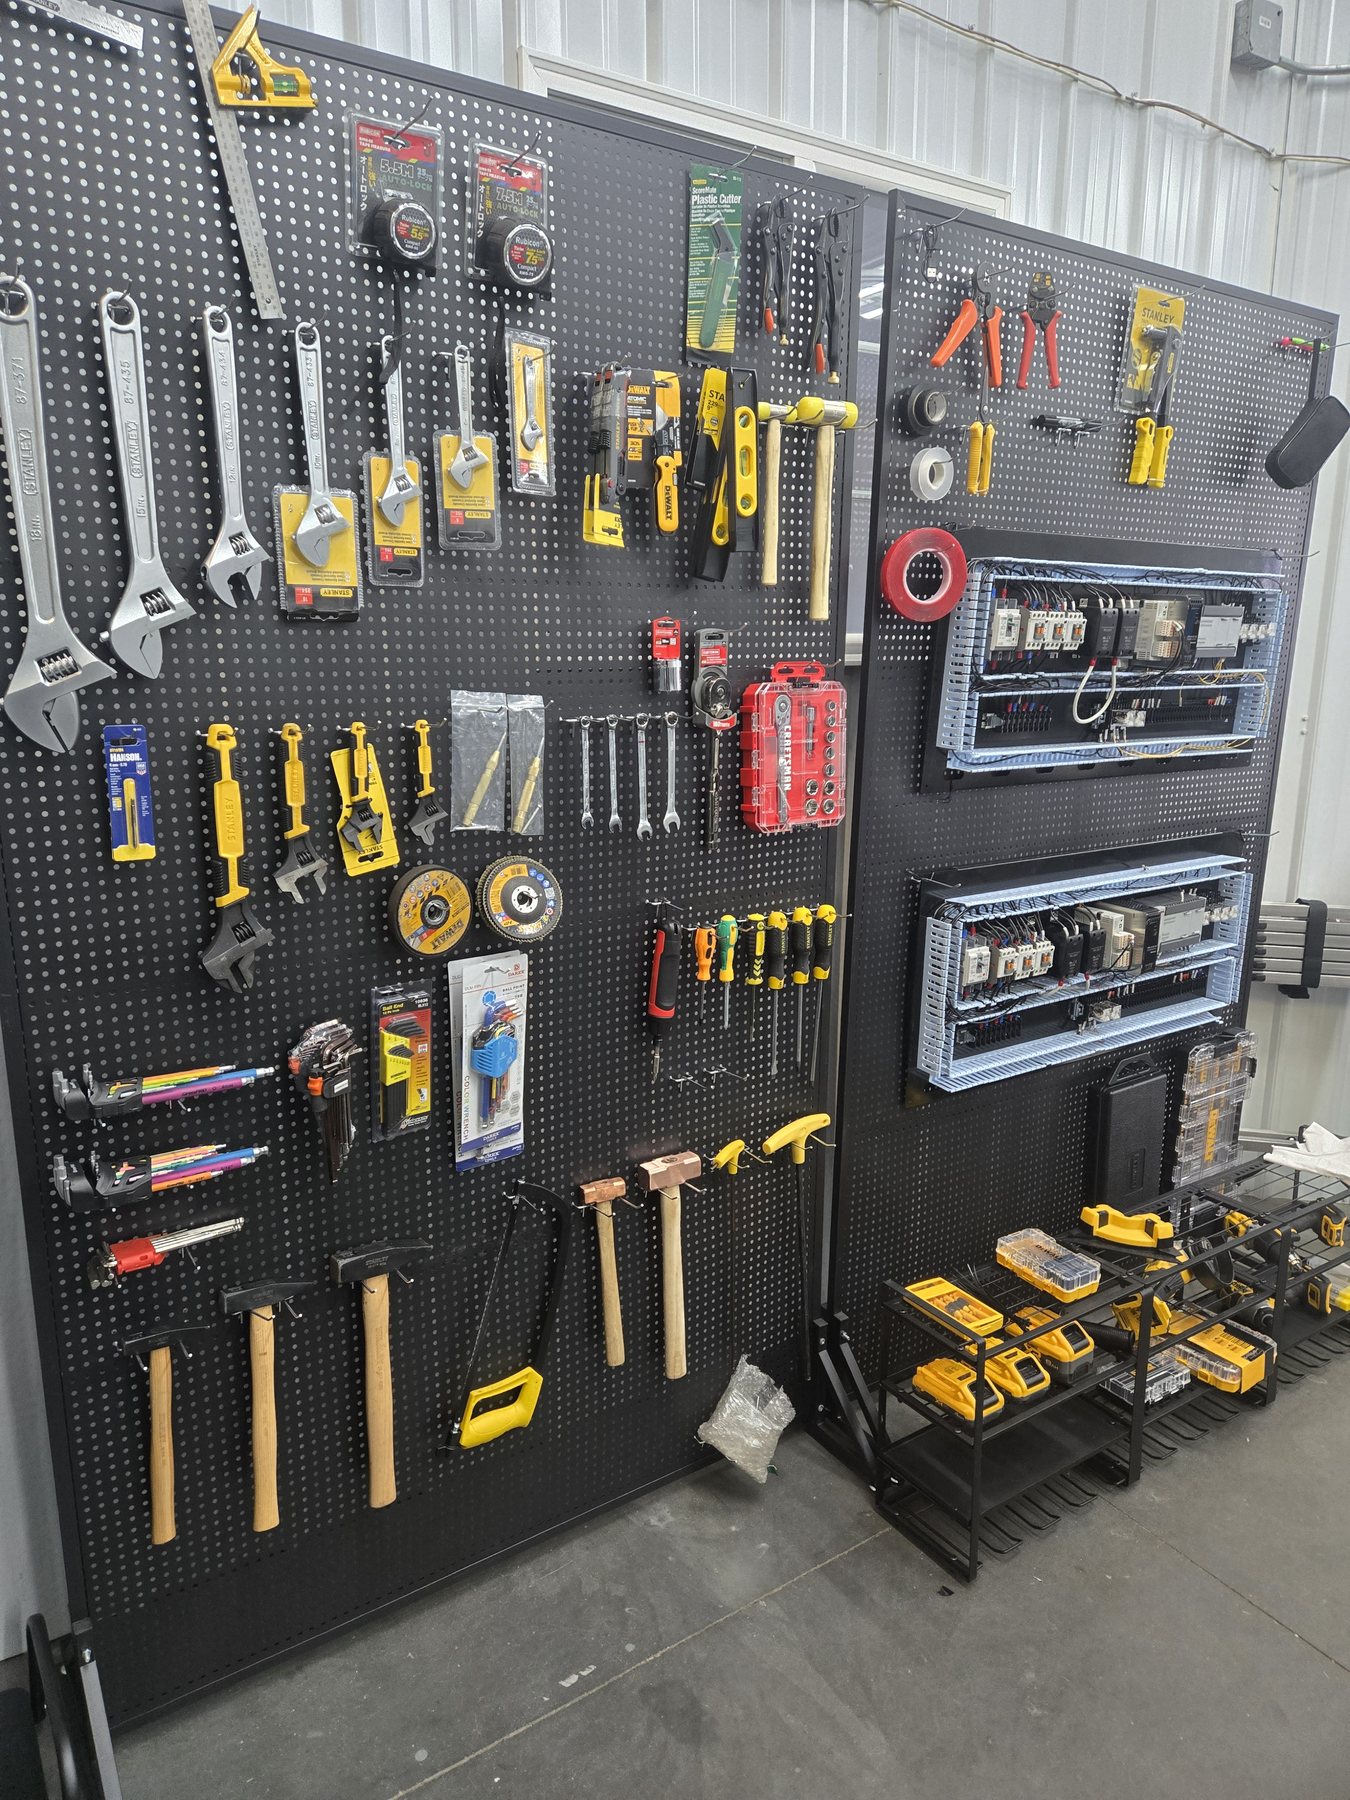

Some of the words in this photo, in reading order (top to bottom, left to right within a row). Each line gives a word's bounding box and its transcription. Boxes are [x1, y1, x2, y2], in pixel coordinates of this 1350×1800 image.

[381, 158, 414, 178] 5.5M
[496, 186, 522, 205] 7.5M
[692, 194, 718, 205] Plastic
[719, 193, 741, 204] Cutter
[1142, 308, 1174, 324] STANLEY
[223, 403, 233, 449] STANLEY
[309, 401, 319, 440] STANLEY
[19, 431, 36, 493] STANLEY
[127, 424, 142, 477] STANLEY
[664, 486, 672, 520] DEWALT
[110, 753, 139, 762] HANSON
[225, 798, 236, 841] STANLEY
